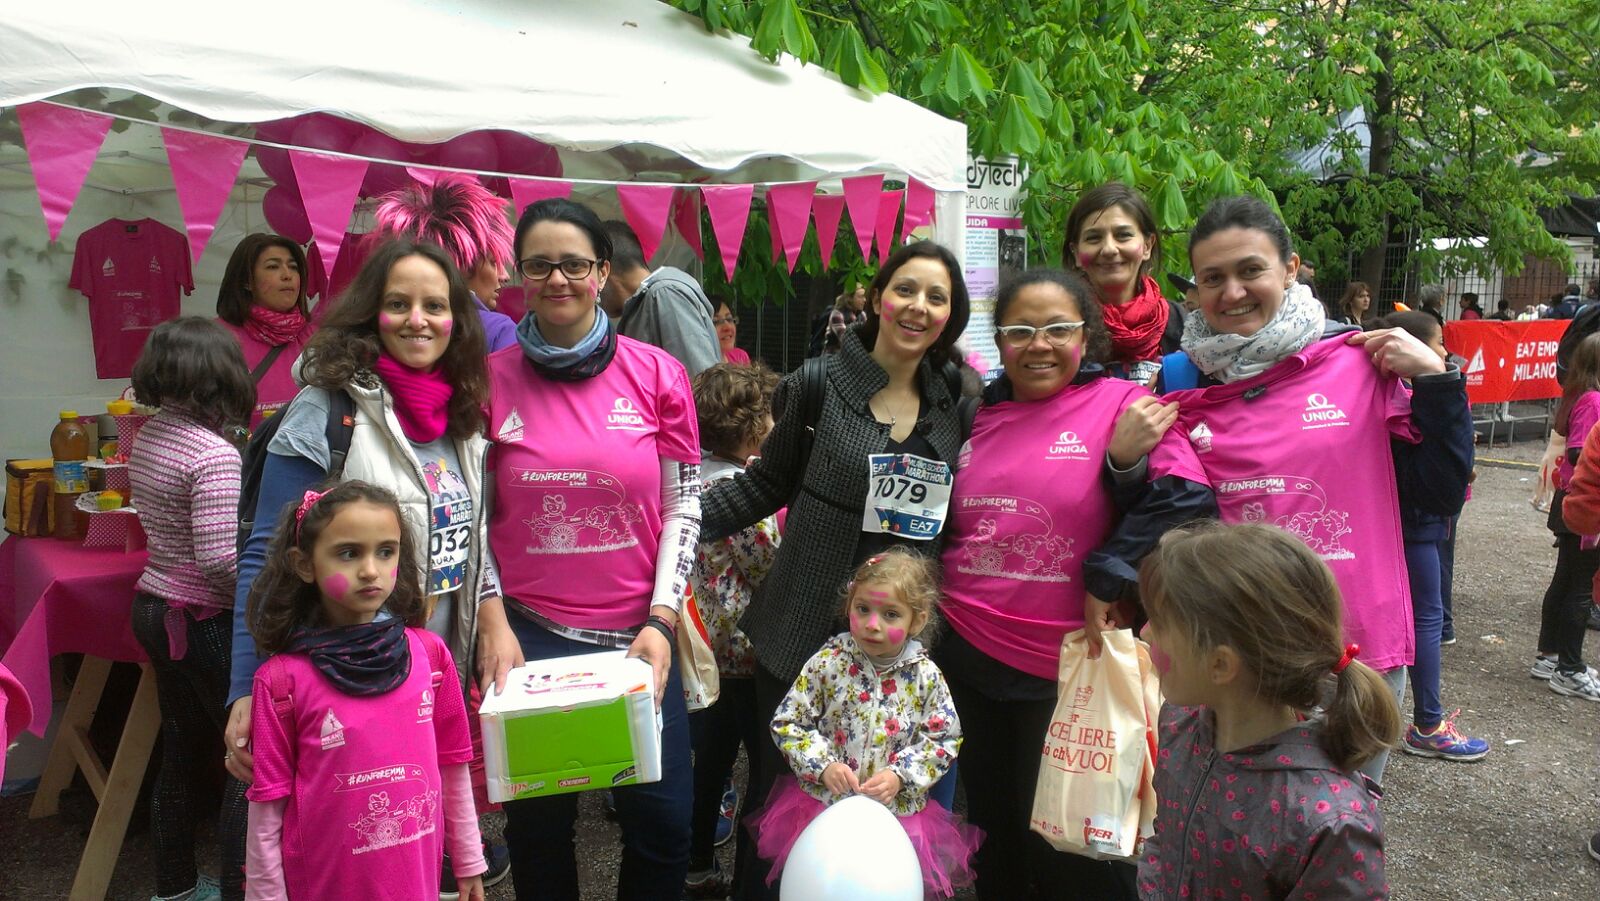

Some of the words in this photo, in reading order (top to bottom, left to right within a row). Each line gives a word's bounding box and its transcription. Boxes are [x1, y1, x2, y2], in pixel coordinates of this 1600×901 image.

[1515, 342, 1536, 359] EA7
[1512, 361, 1557, 382] MILANO
[607, 415, 644, 425] UNIQA
[1302, 409, 1347, 423] UNIQA
[1049, 445, 1088, 454] UNIQA
[873, 463, 887, 473] EA7
[521, 471, 587, 482] #RUNFOREMMA
[874, 477, 927, 504] 1079
[1219, 478, 1286, 493] #RUNFOREMMA
[962, 497, 1018, 508] #RUNFOREMMA
[909, 519, 934, 532] EA7
[1066, 748, 1114, 774] VUOI
[347, 766, 405, 786] #RUNFOREMMA
